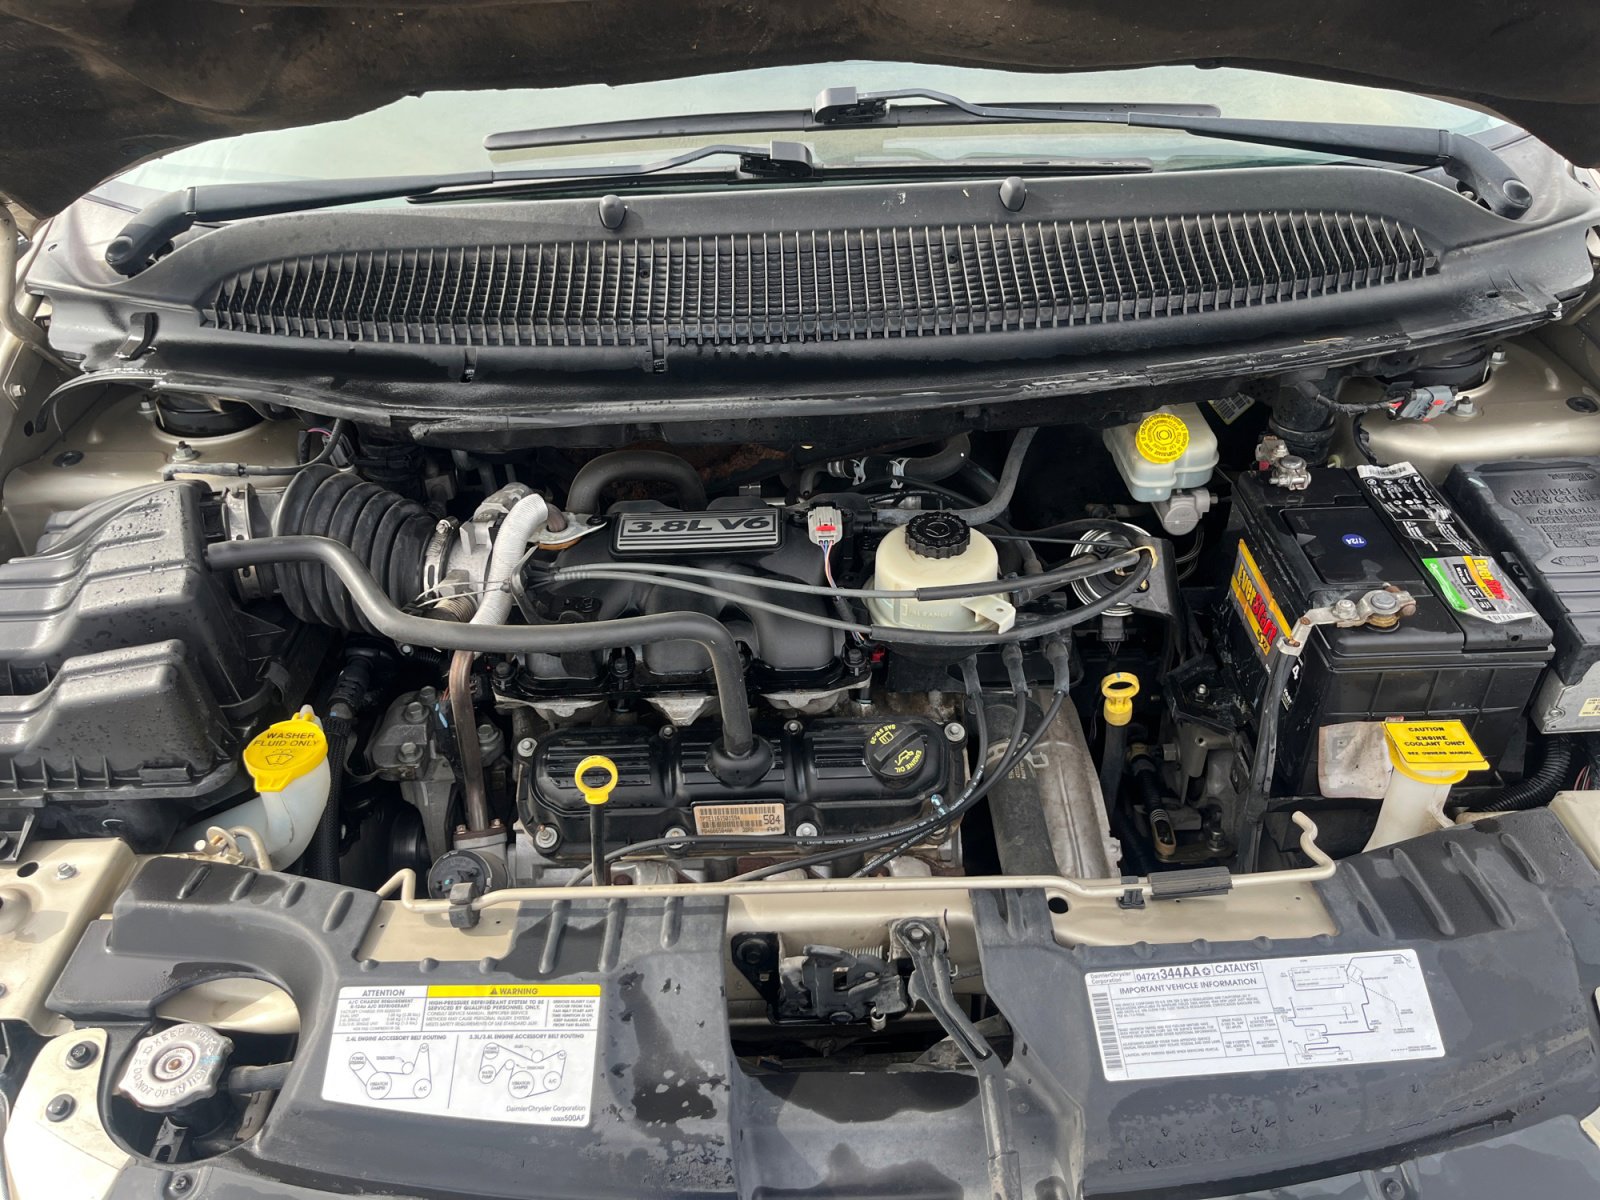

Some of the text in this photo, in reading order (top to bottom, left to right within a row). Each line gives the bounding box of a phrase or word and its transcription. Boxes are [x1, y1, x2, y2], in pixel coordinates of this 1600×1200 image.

[628, 516, 770, 532] 3.8L V6
[883, 724, 896, 732] SAE
[904, 750, 922, 770] ENGINE
[1136, 966, 1201, 982] 04721344AA
[1215, 962, 1260, 974] CATALYST
[1120, 978, 1257, 994] IMPORTANT VEHICLE INFORMATION
[153, 1026, 185, 1046] KEEP
[154, 1084, 186, 1098] OPEN
